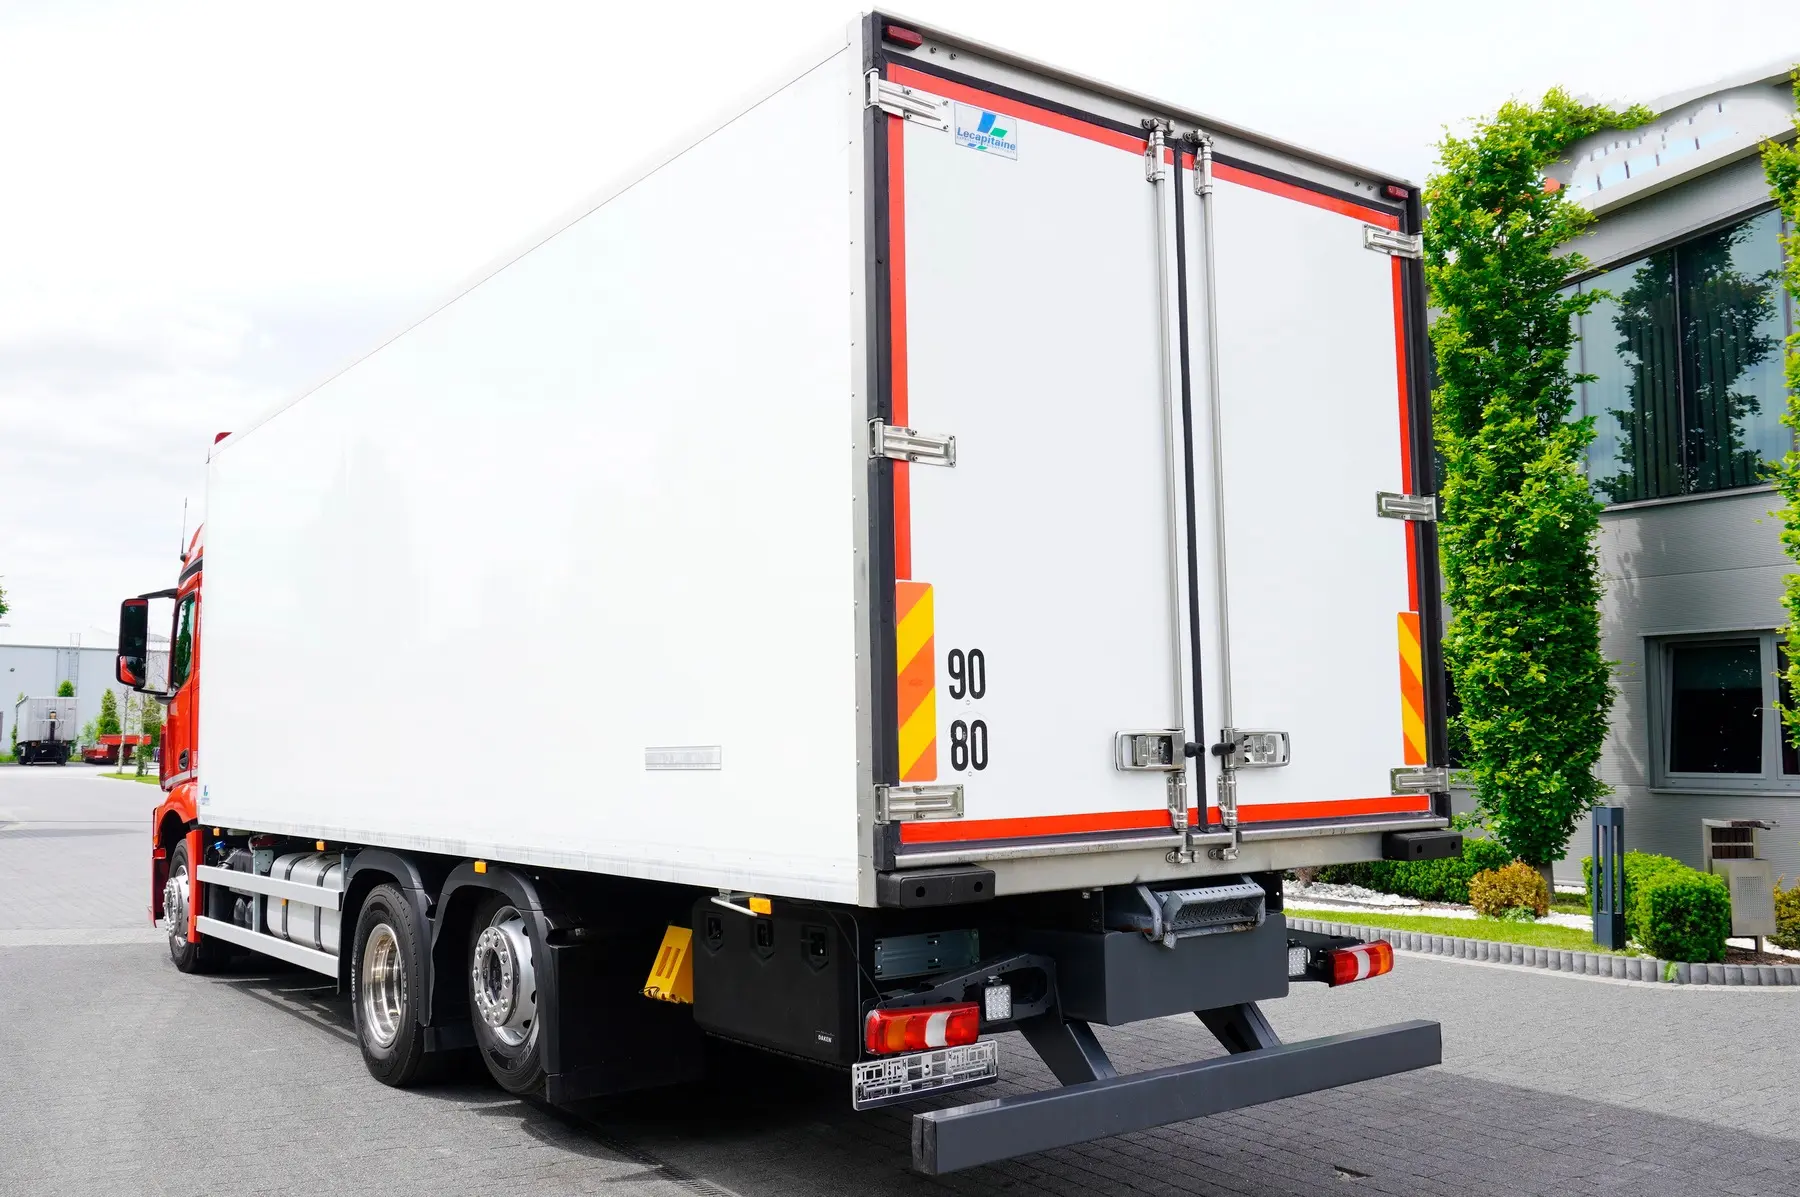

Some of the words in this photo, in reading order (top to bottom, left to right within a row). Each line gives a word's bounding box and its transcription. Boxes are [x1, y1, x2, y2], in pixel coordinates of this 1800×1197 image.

[956, 127, 1016, 151] Lecapitaine
[947, 648, 986, 700] 90
[950, 719, 989, 771] 80
